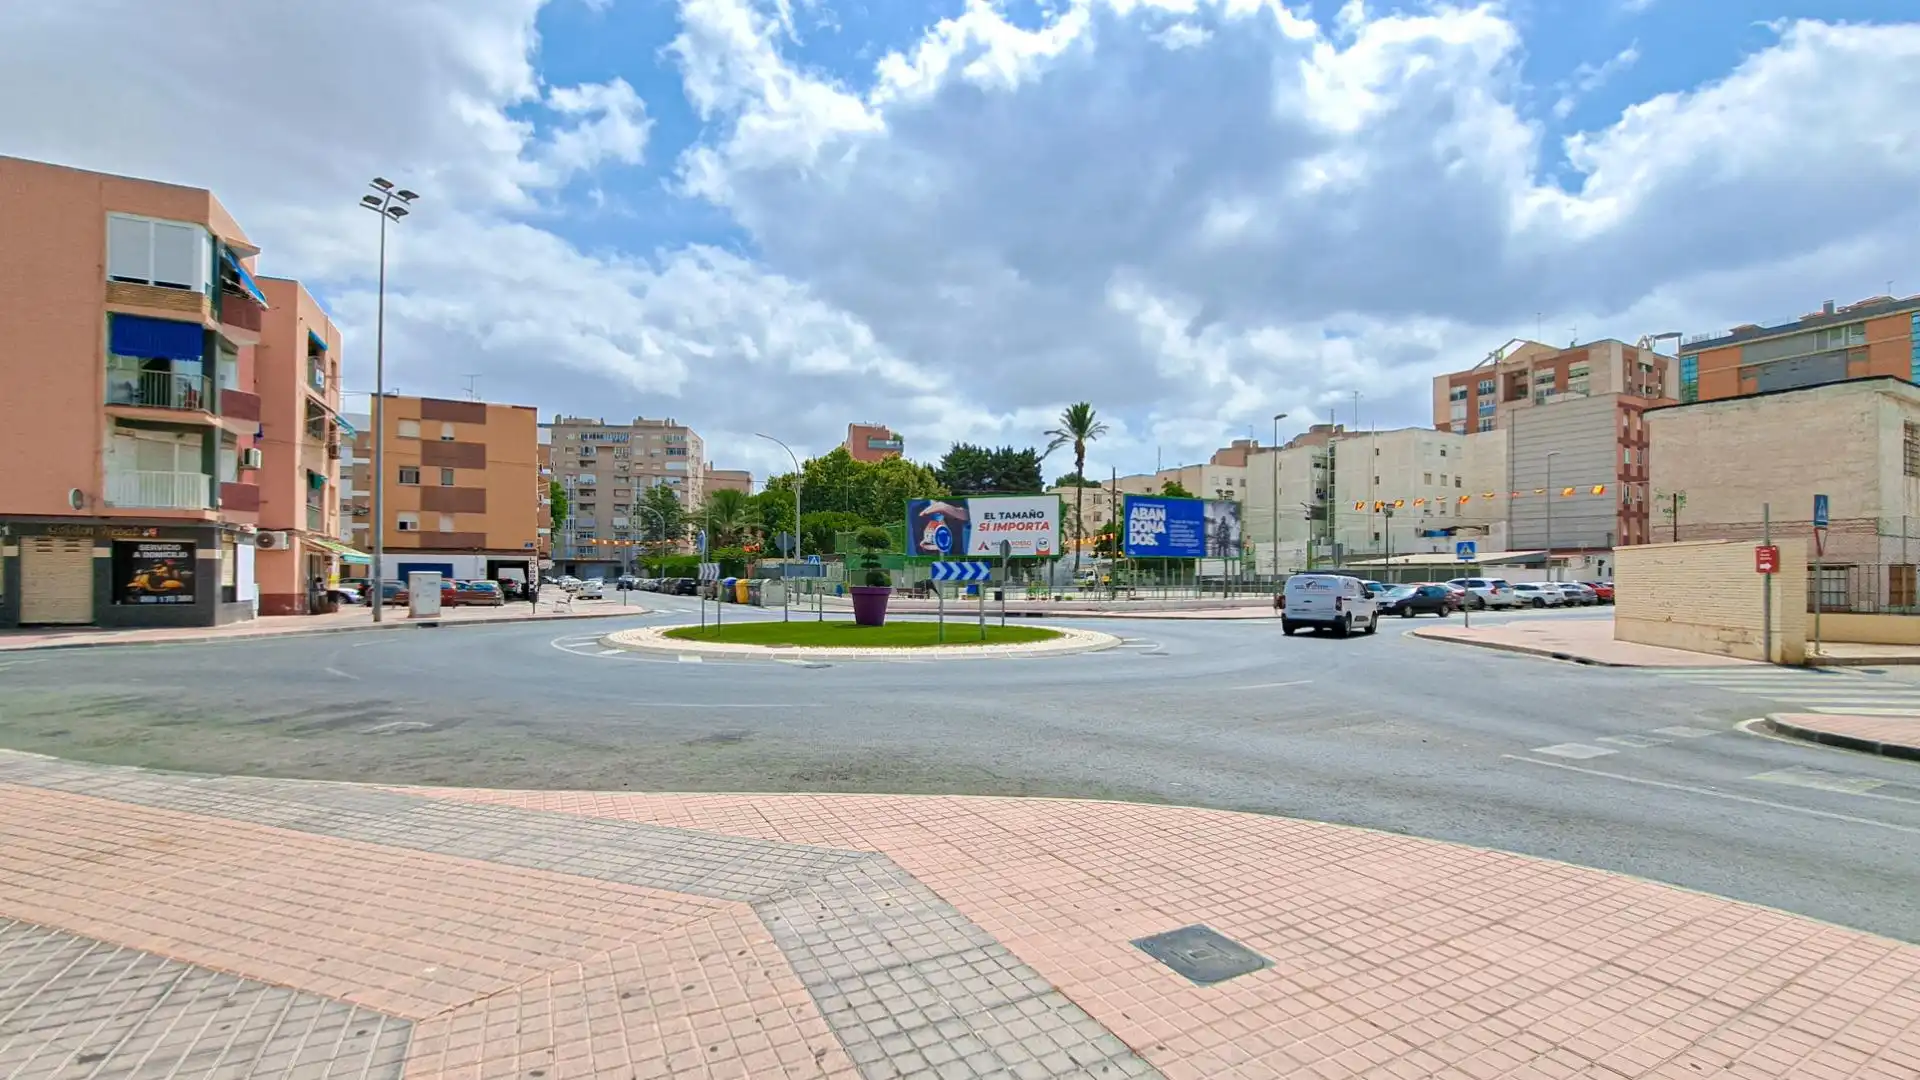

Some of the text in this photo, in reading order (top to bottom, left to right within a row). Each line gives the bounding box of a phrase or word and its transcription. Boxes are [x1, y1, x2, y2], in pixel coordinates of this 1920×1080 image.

[984, 508, 1044, 520] EL TAMAÑO
[1130, 507, 1166, 521] ABAN
[993, 520, 1050, 531] IMPORTA
[1129, 520, 1166, 533] DONA
[1129, 533, 1159, 546] DOS.
